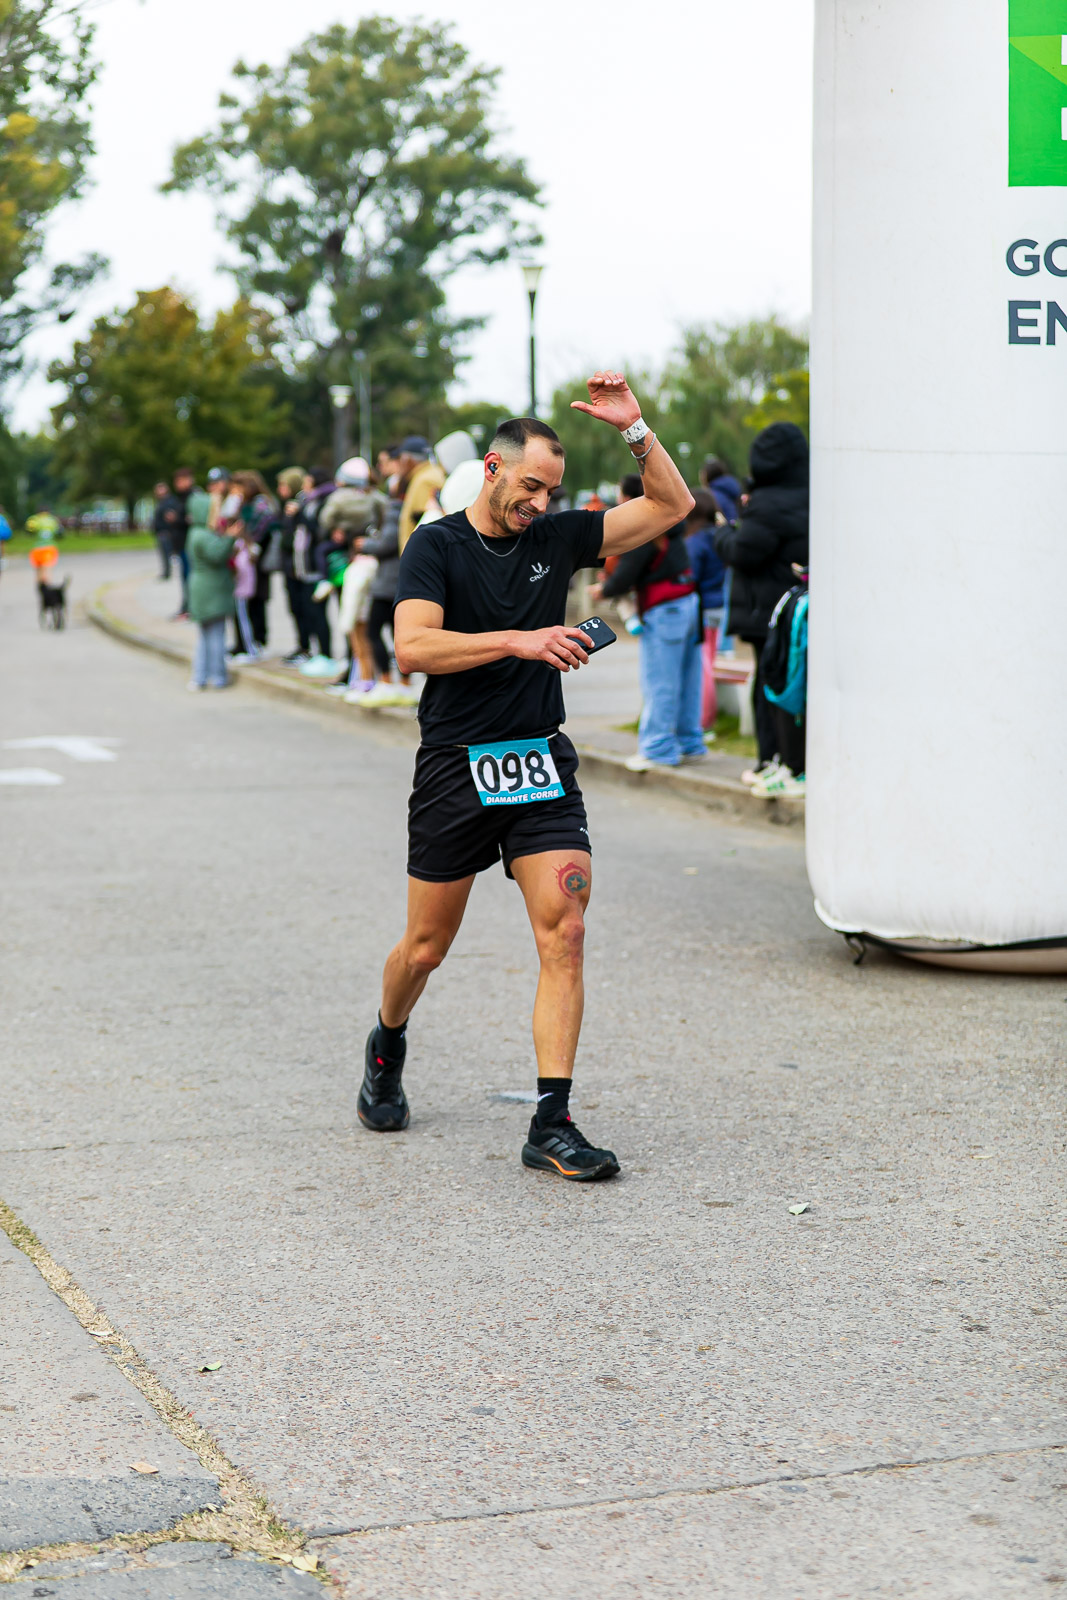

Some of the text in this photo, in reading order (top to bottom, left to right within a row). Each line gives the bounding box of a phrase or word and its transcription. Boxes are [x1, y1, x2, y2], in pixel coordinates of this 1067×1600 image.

[476, 749, 551, 794] 098
[486, 789, 559, 804] DIAMANTE CORRE
